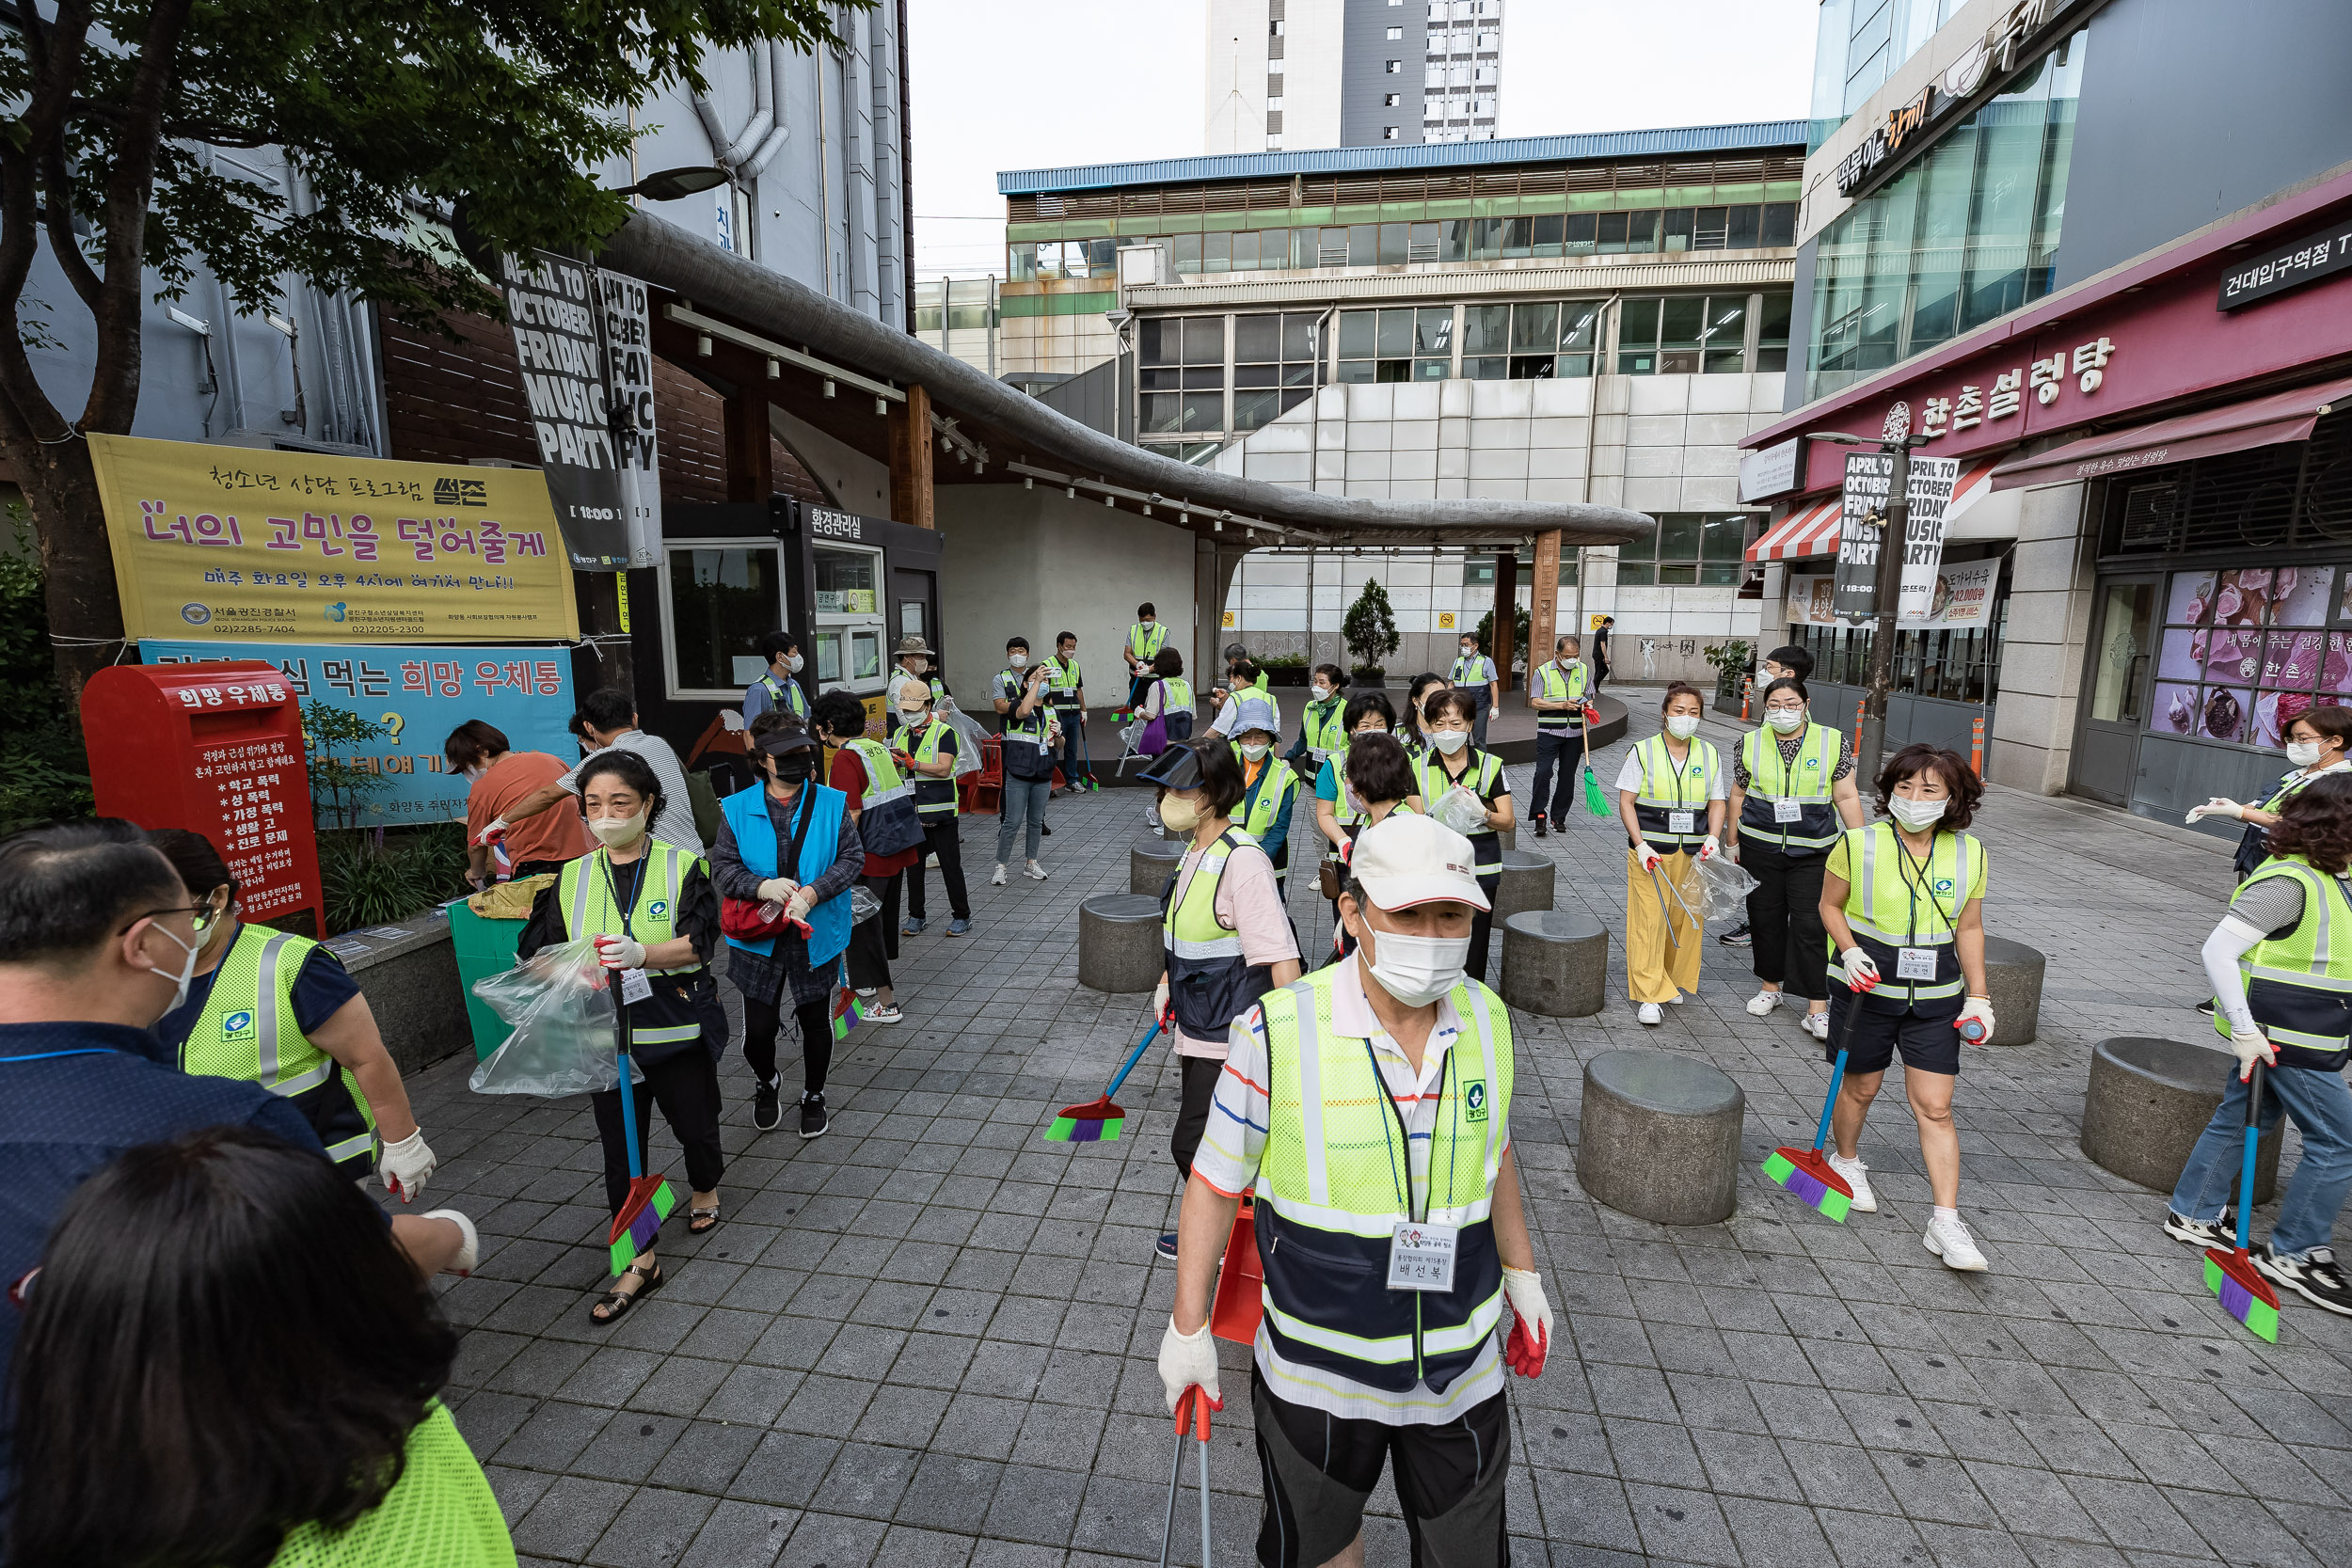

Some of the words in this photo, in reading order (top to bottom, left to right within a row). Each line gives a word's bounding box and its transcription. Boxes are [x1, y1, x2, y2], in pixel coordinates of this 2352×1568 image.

[1836, 130, 1885, 192] 떡볶이로
[2226, 240, 2331, 297] 건대입구역점
[559, 264, 585, 301] TO
[508, 287, 594, 337] OCTOBER
[513, 325, 599, 379] FRIDAY
[1921, 337, 2116, 438] 한촌설렁탕
[522, 372, 609, 426] MUSIC
[534, 420, 616, 470] PARTY
[1941, 462, 1956, 479] TO
[2075, 461, 2099, 476] 정직한
[2099, 458, 2114, 471] 육수,
[2116, 454, 2140, 468] 맛있는
[2141, 449, 2169, 465] 설렁탕
[209, 465, 281, 491] 청소년
[290, 474, 341, 496] 상담
[348, 476, 424, 502] 프로그램
[433, 478, 488, 507] 썰존
[580, 505, 613, 520] 18:00
[1908, 497, 1948, 518] RIDAY
[139, 499, 244, 546] 너의
[265, 511, 379, 562] 고민을
[396, 517, 547, 564] 덜어줄게
[811, 508, 861, 539] 환경관리실
[1908, 519, 1943, 543] USIC
[1902, 544, 1941, 566] ARTY
[204, 568, 244, 587] 매주
[252, 571, 309, 589] 화요일
[317, 572, 348, 589] 오후
[355, 573, 404, 588] 4시에
[411, 574, 461, 589] 여기서
[469, 575, 515, 591] 만나!!
[1947, 568, 1990, 587] 도가니수육
[214, 607, 296, 617] 서울광진경찰서
[214, 625, 296, 634] 02)2285-7404
[352, 626, 424, 634] 02)2205-2300
[2226, 633, 2238, 648] 내
[2267, 635, 2293, 649] 주는
[321, 659, 391, 698] 먹는
[400, 660, 465, 698] 희망
[473, 661, 563, 697] 우체통
[178, 687, 224, 708] 희망
[227, 683, 287, 705] 우체통
[229, 746, 246, 759] 근심
[246, 744, 268, 757] 위기와
[269, 741, 285, 753] 절망
[195, 766, 213, 780] 혼자
[215, 761, 248, 776] 고민하지
[247, 758, 265, 771] 말고
[265, 753, 296, 768] 함께해요
[229, 779, 254, 792] 학교
[257, 773, 280, 787] 폭력
[231, 795, 244, 807] 성
[246, 790, 270, 803] 폭력
[389, 800, 425, 813] 화양동
[233, 807, 258, 821] 가정
[261, 801, 284, 816] 폭력
[235, 822, 260, 836] 생활
[264, 818, 277, 831] 고
[237, 837, 262, 851] 진로
[264, 830, 288, 845] 문제
[249, 854, 262, 864] 매일
[264, 847, 291, 861] 수거하며
[266, 858, 293, 871] 비밀보장
[246, 882, 301, 903] 화양동주민자치회
[248, 892, 302, 913] 청소년교육분과
[224, 1029, 251, 1040] 광진구
[1468, 1108, 1486, 1118] 광진구
[1397, 1254, 1423, 1262] 통장협의회
[1424, 1257, 1447, 1265] 제15통장
[1400, 1263, 1410, 1276] 배
[1415, 1265, 1425, 1278] 선
[1430, 1266, 1441, 1279] 복
